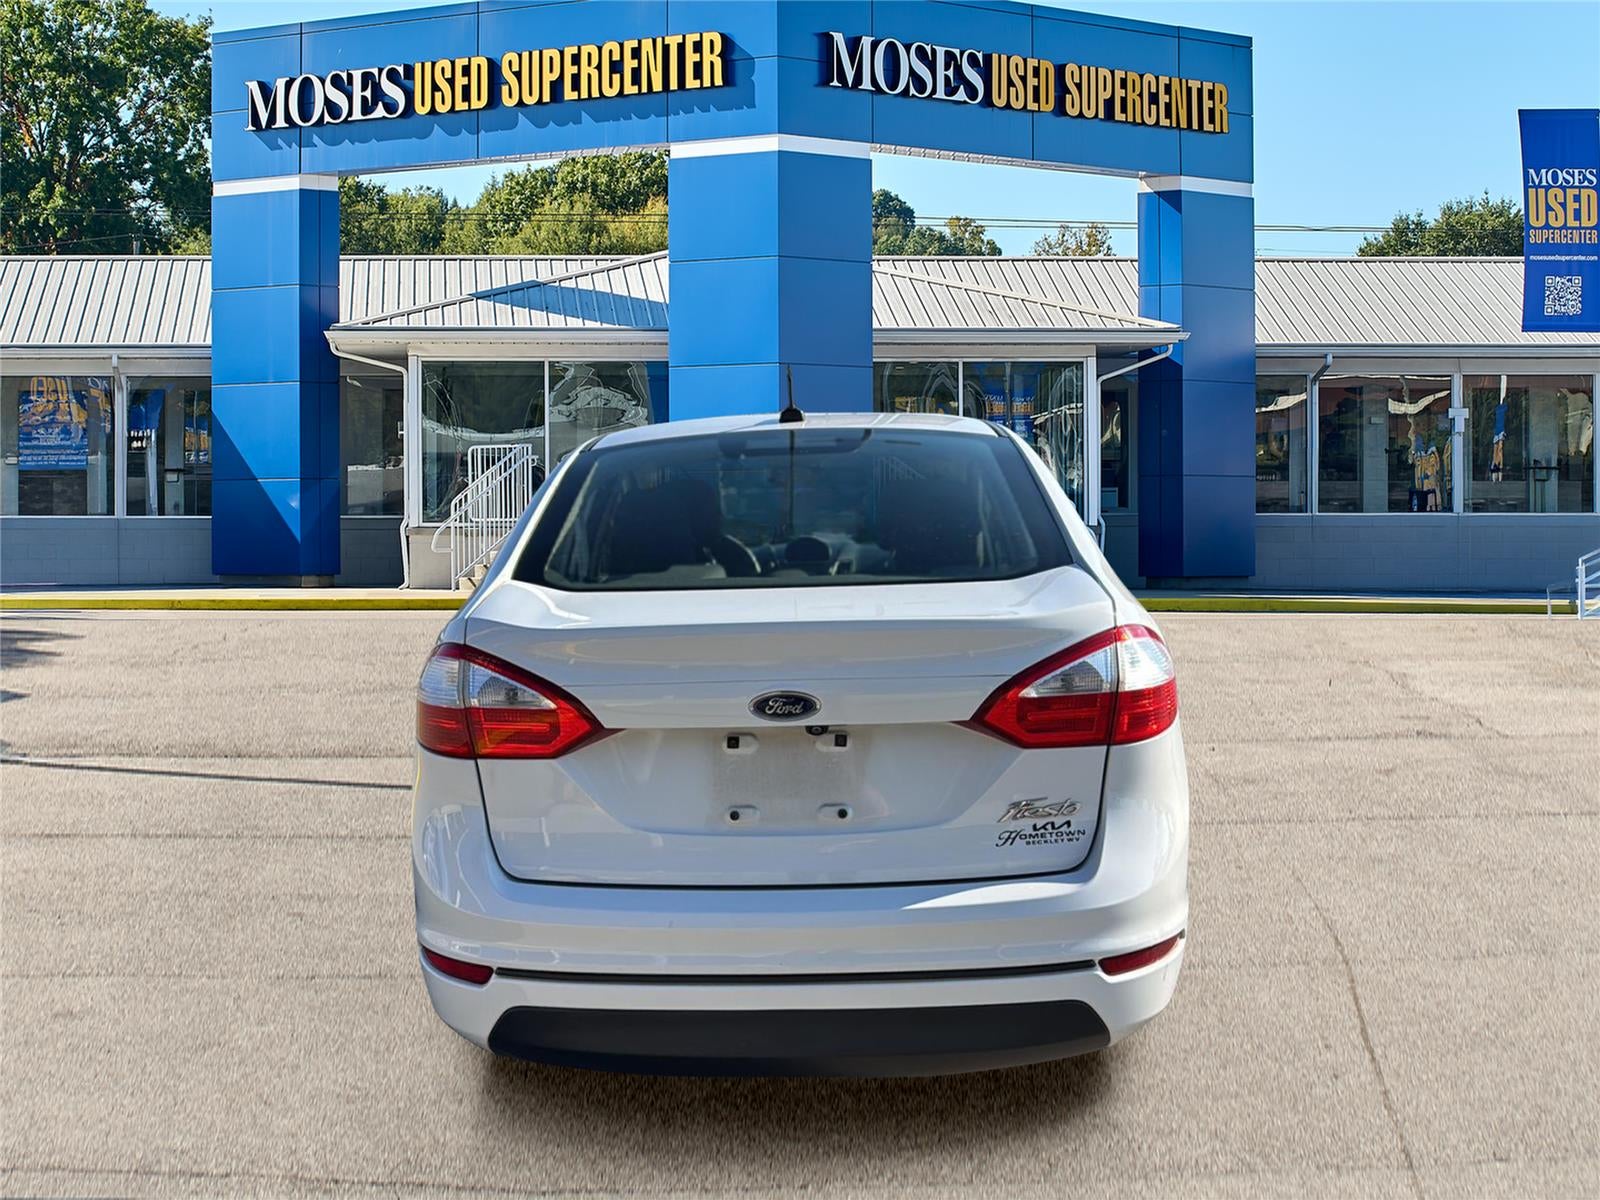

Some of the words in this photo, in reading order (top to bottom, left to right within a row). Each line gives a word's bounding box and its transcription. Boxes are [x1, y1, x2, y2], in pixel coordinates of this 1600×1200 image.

[246, 64, 406, 131] MOSES
[413, 56, 489, 115] USED
[501, 31, 724, 107] SUPERCENTER
[829, 31, 984, 104] MOSES
[991, 53, 1055, 112] USED
[1065, 63, 1229, 133] SUPERCENTER
[1527, 168, 1597, 186] MOSES
[1528, 188, 1598, 227] USED
[1529, 229, 1598, 244] SUPERCENTER
[765, 697, 804, 714] Ford
